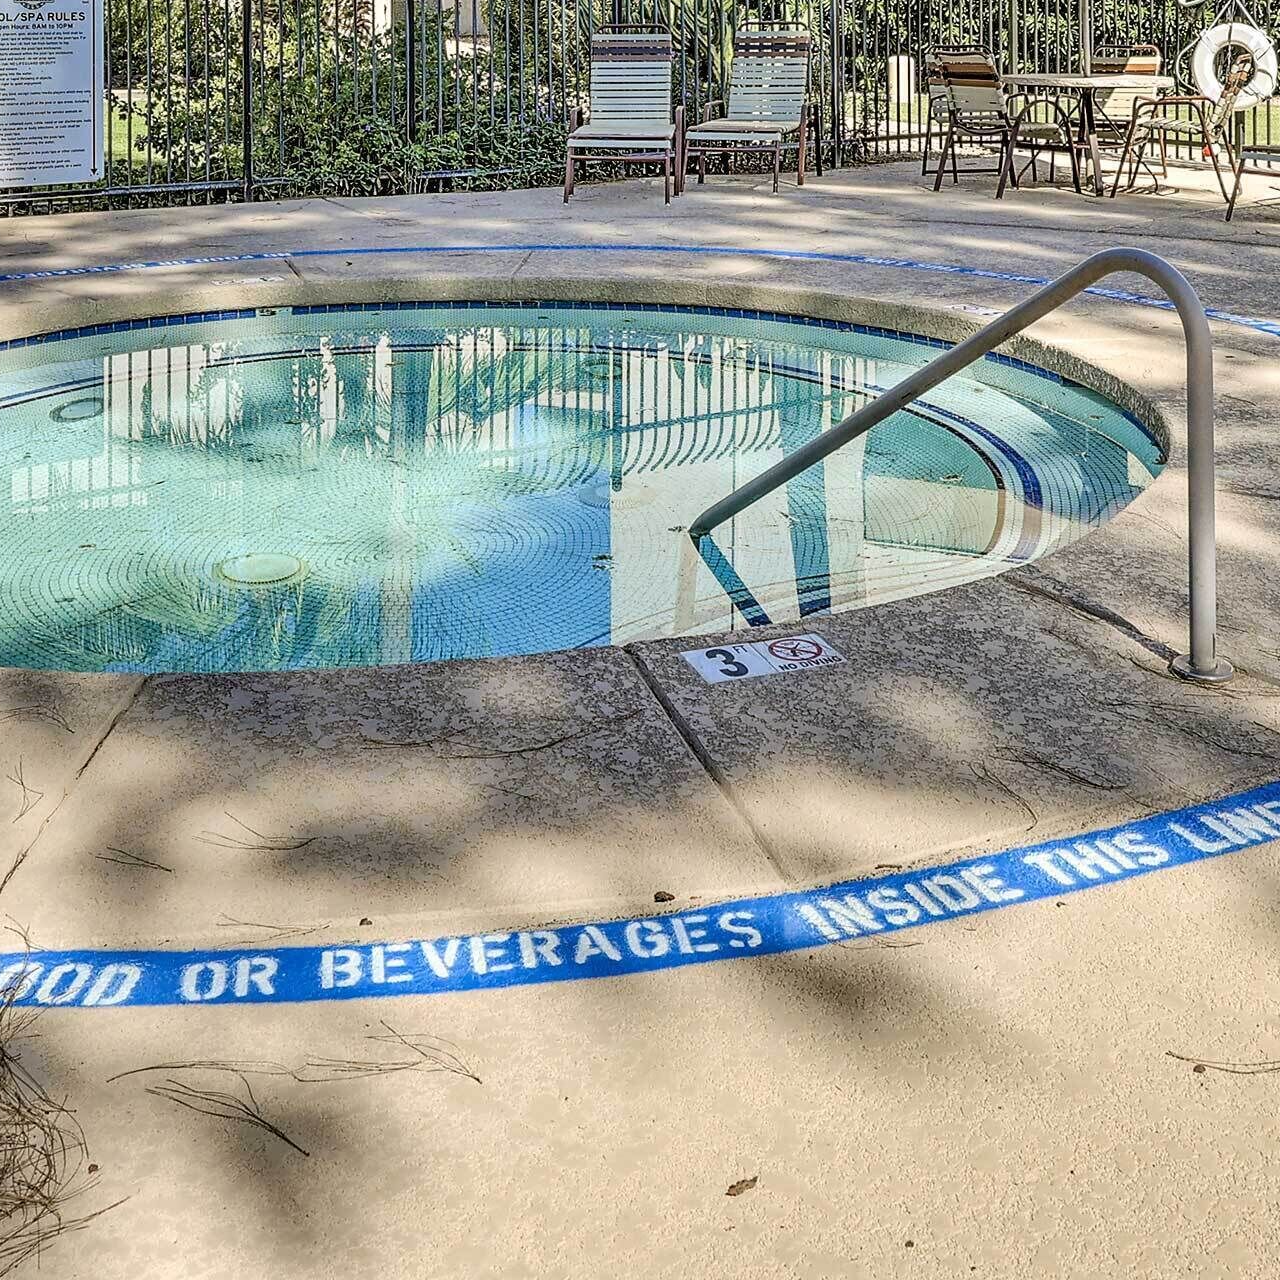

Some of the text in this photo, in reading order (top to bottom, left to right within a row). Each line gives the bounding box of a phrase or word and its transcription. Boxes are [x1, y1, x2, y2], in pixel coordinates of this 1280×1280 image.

[47, 11, 86, 21] RULES
[705, 644, 749, 677] 3 FT
[778, 655, 843, 672] NO DIVING
[180, 956, 280, 1003] OR
[319, 910, 764, 991] BEVERAGES
[796, 864, 1026, 942] INSIDE
[1021, 830, 1170, 886] THIS
